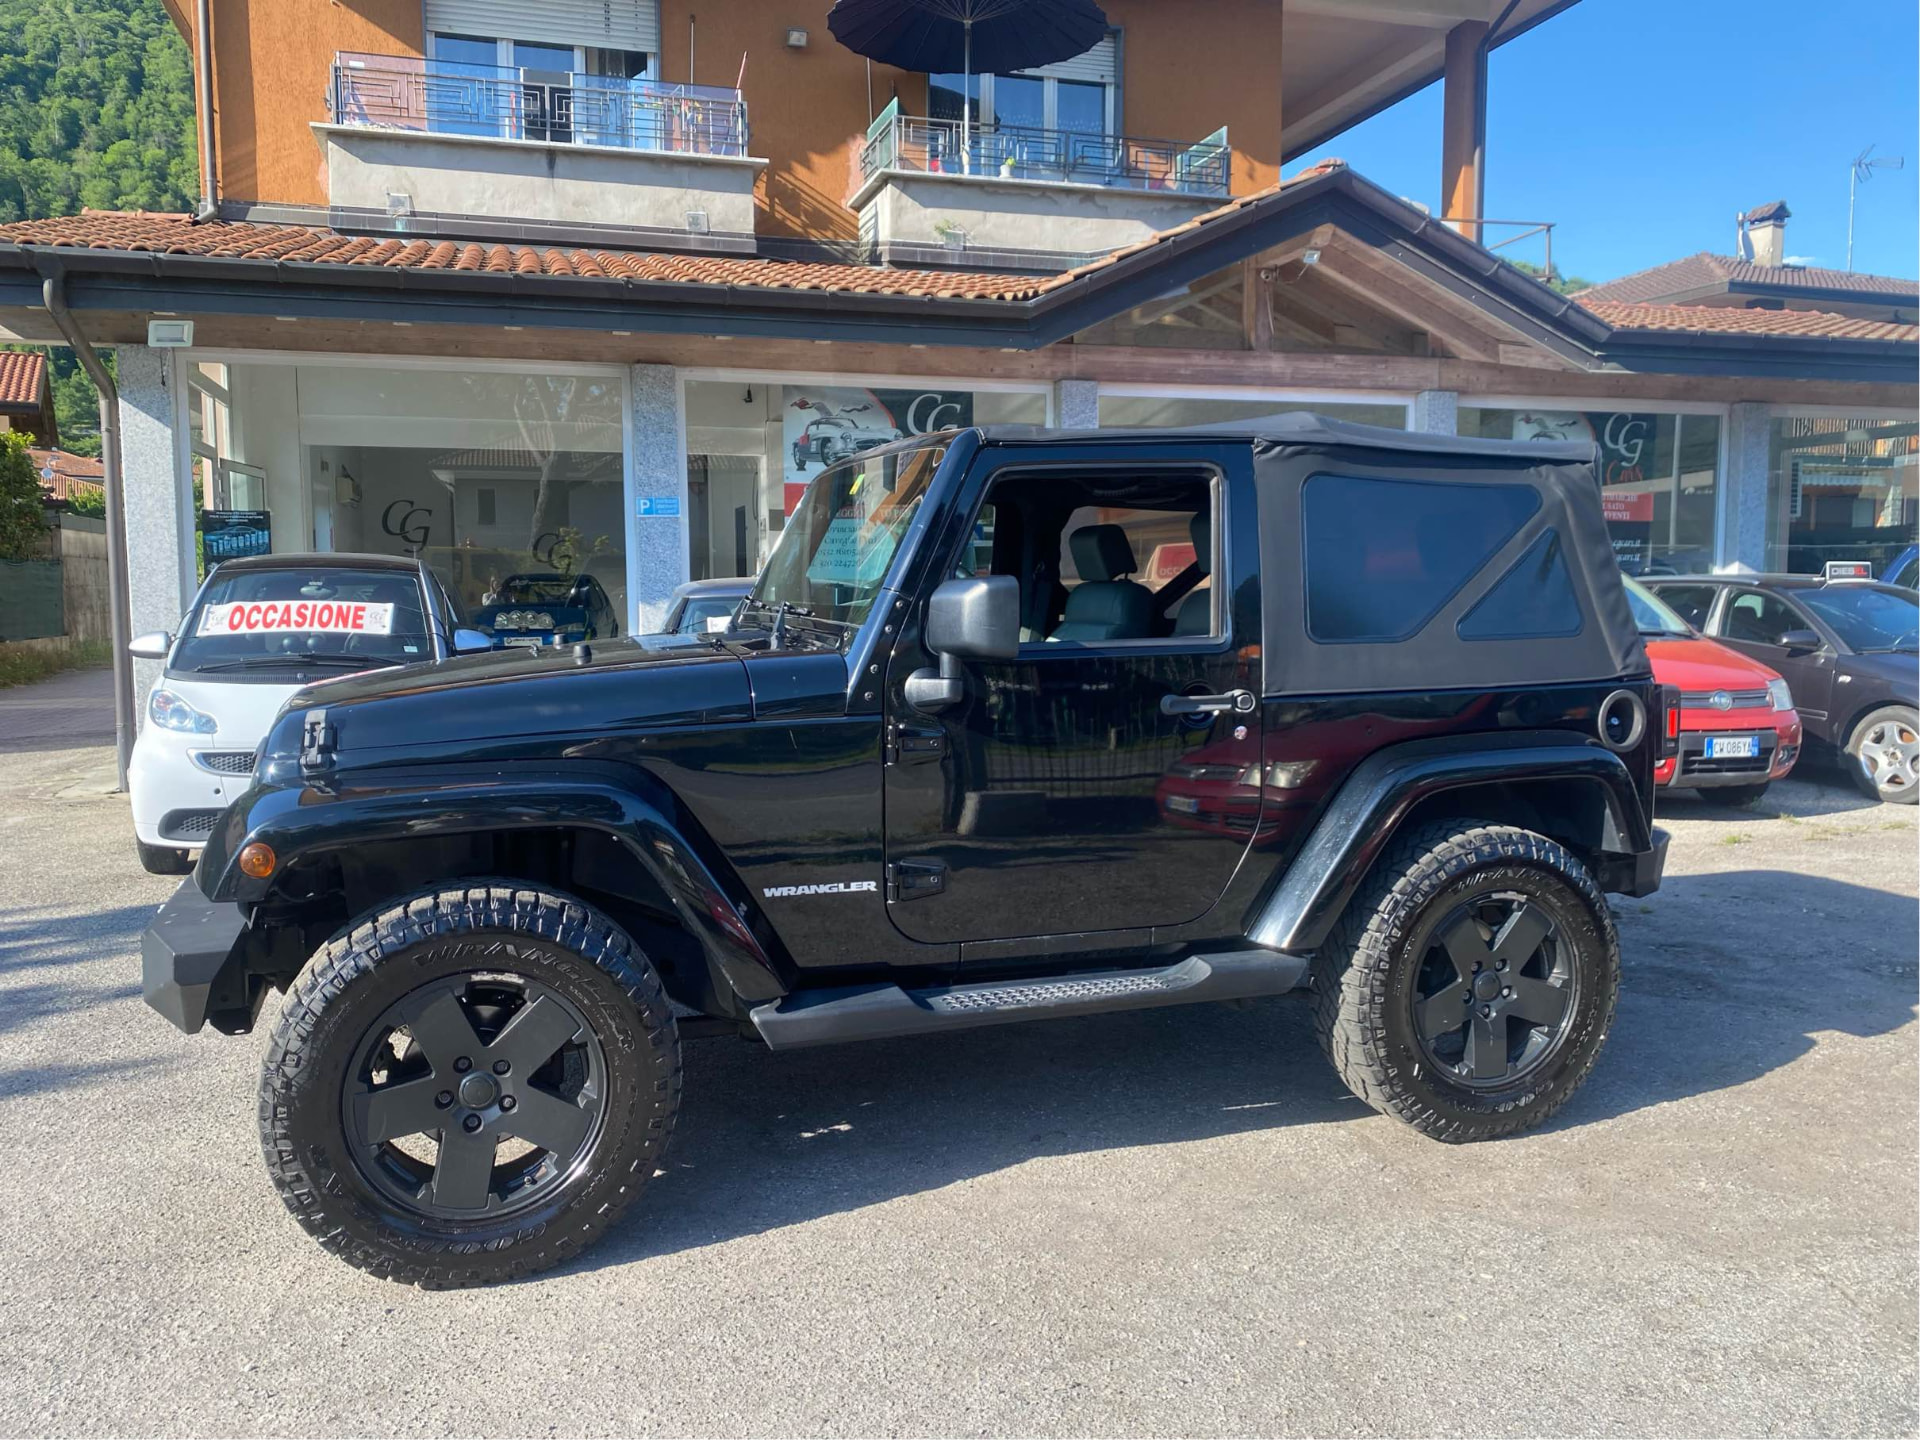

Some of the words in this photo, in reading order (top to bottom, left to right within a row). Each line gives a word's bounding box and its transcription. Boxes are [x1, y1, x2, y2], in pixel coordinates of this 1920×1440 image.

[1603, 412, 1647, 467] CG
[640, 499, 650, 514] P
[381, 500, 433, 553] CG
[1831, 567, 1868, 576] DIESEL
[228, 603, 366, 632] OCCASIONE
[763, 880, 878, 898] WRANGLER
